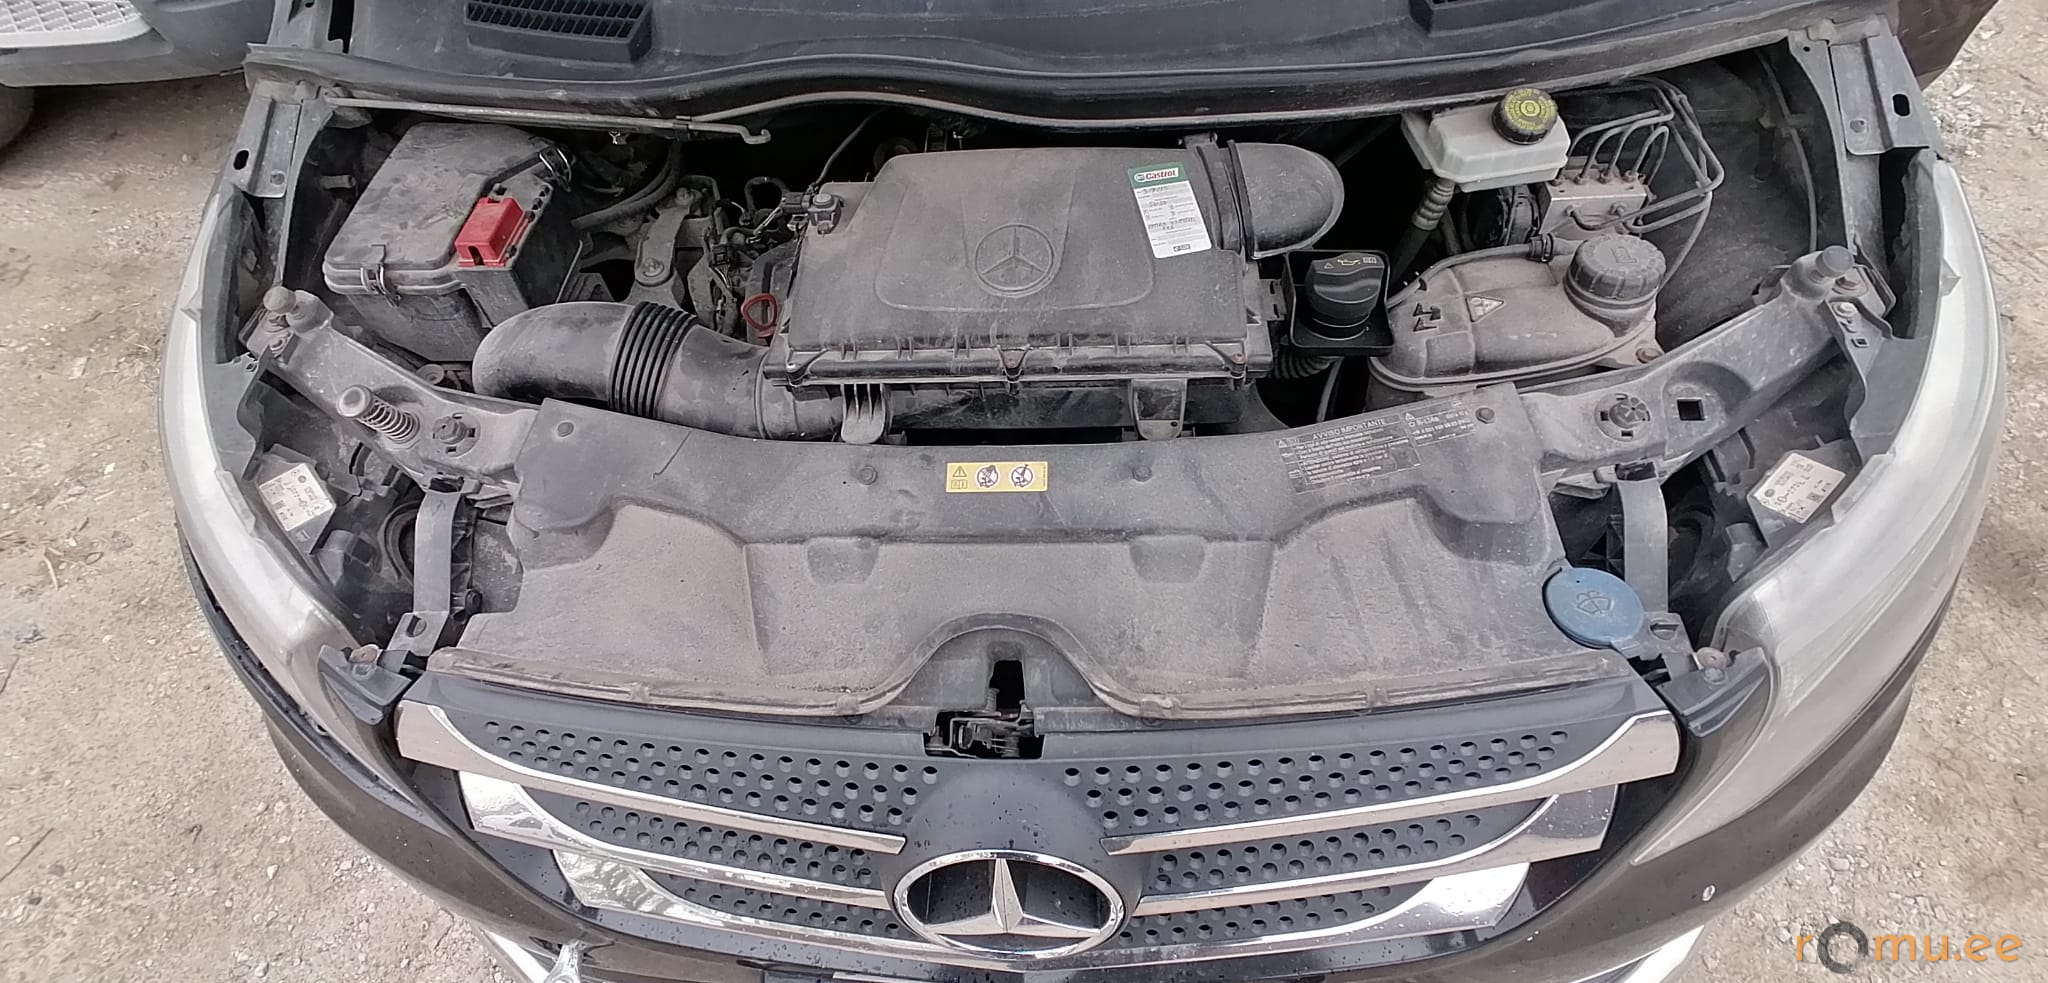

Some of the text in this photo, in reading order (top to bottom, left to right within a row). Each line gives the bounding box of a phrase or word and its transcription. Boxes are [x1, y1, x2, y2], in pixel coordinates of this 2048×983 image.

[1145, 169, 1176, 181] Castrol
[1312, 418, 1386, 441] AVVISO IMPORTANTE
